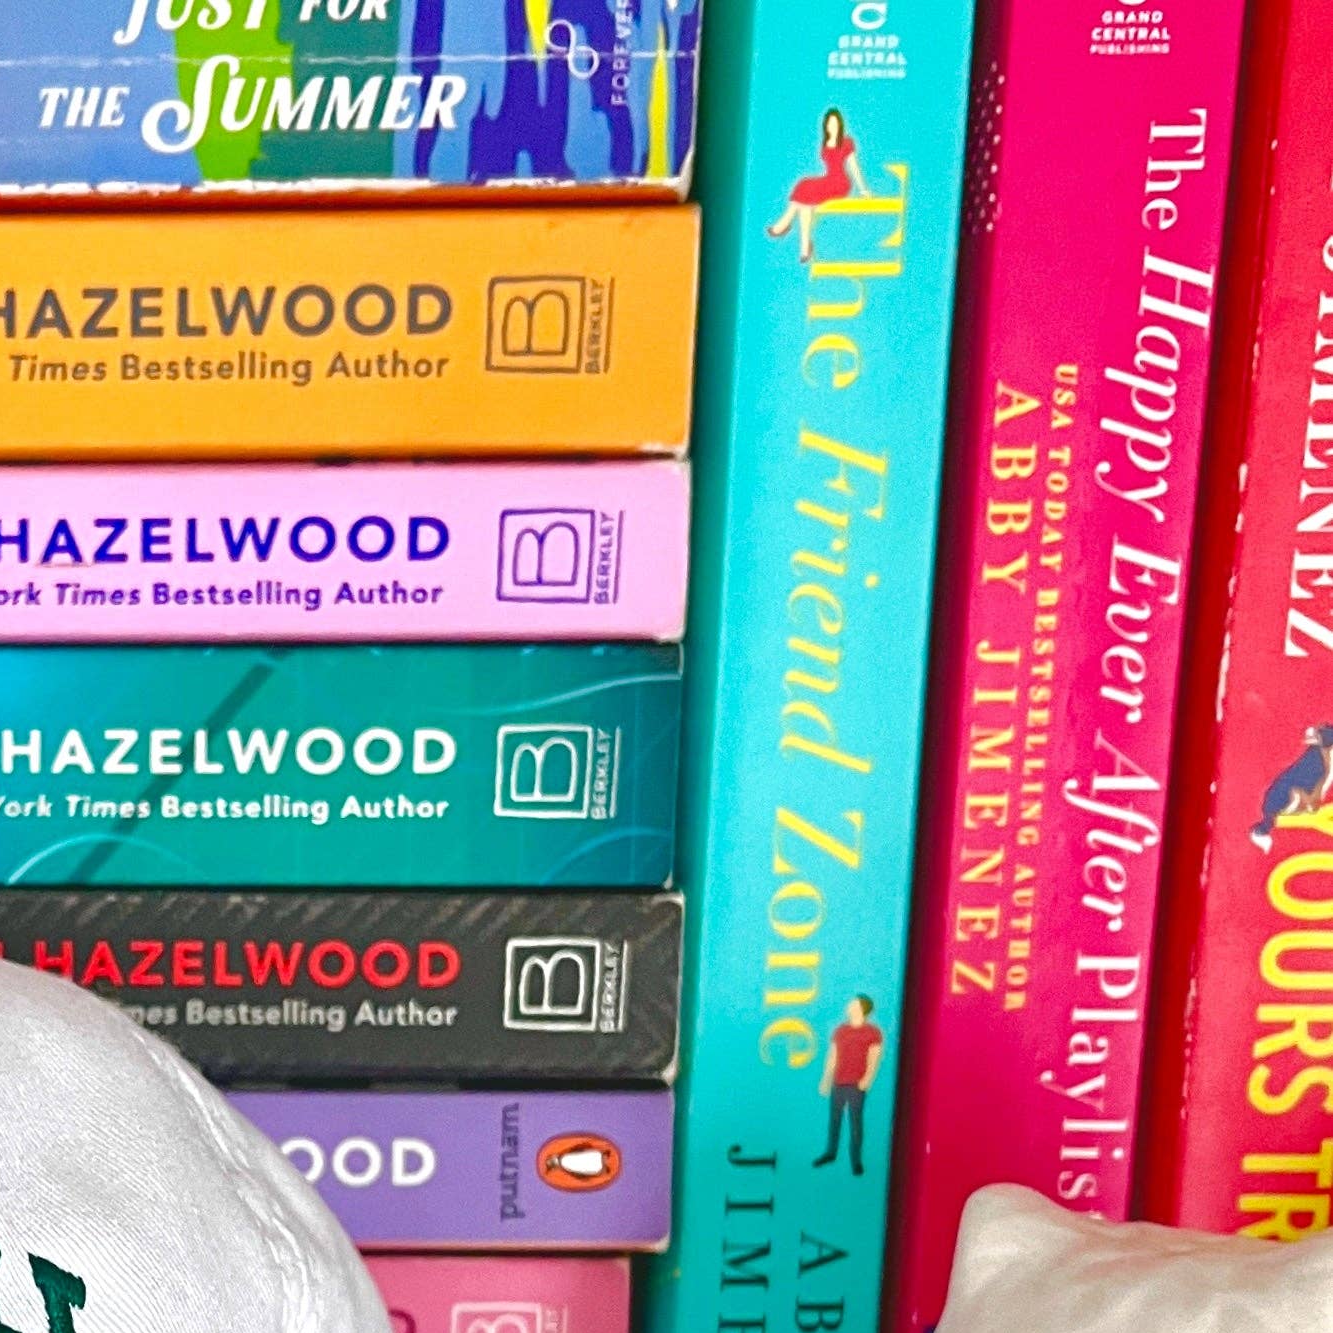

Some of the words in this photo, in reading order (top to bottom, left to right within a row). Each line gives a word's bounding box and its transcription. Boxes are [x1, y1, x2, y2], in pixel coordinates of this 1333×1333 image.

[1091, 27, 1171, 41] CENTRAL
[1101, 10, 1164, 25] GRAND
[38, 86, 130, 128] THE
[141, 54, 469, 154] SUMMER
[1141, 108, 1208, 230] The
[801, 162, 910, 389] The
[9, 354, 108, 382] Times
[120, 351, 312, 387] Bestselling
[326, 352, 450, 379] Author
[1051, 363, 1079, 430] USA
[1094, 246, 1216, 523] Happy
[982, 378, 1043, 594] ABBY
[1040, 447, 1072, 570] TODAY
[55, 583, 141, 606] Times
[152, 581, 322, 611] Bestselling
[335, 582, 443, 606] Author
[779, 420, 889, 773] Friend
[1100, 534, 1182, 723] Ever
[1, 726, 457, 775] HAZELWOOD
[1016, 587, 1059, 848] BESTSELLING
[65, 794, 151, 819] Times
[160, 795, 329, 824] Bestselling
[340, 795, 449, 819] Author
[950, 640, 1022, 995] JIMENEZ
[1062, 728, 1162, 931] After
[33, 938, 462, 988] HAZELWOOD
[759, 806, 864, 1070] Zone
[1004, 864, 1036, 1010] AUTHOR
[186, 999, 346, 1032] Bestselling
[354, 1000, 458, 1028] Author
[1039, 951, 1142, 1219] Playlis
[500, 1103, 524, 1222] putnam
